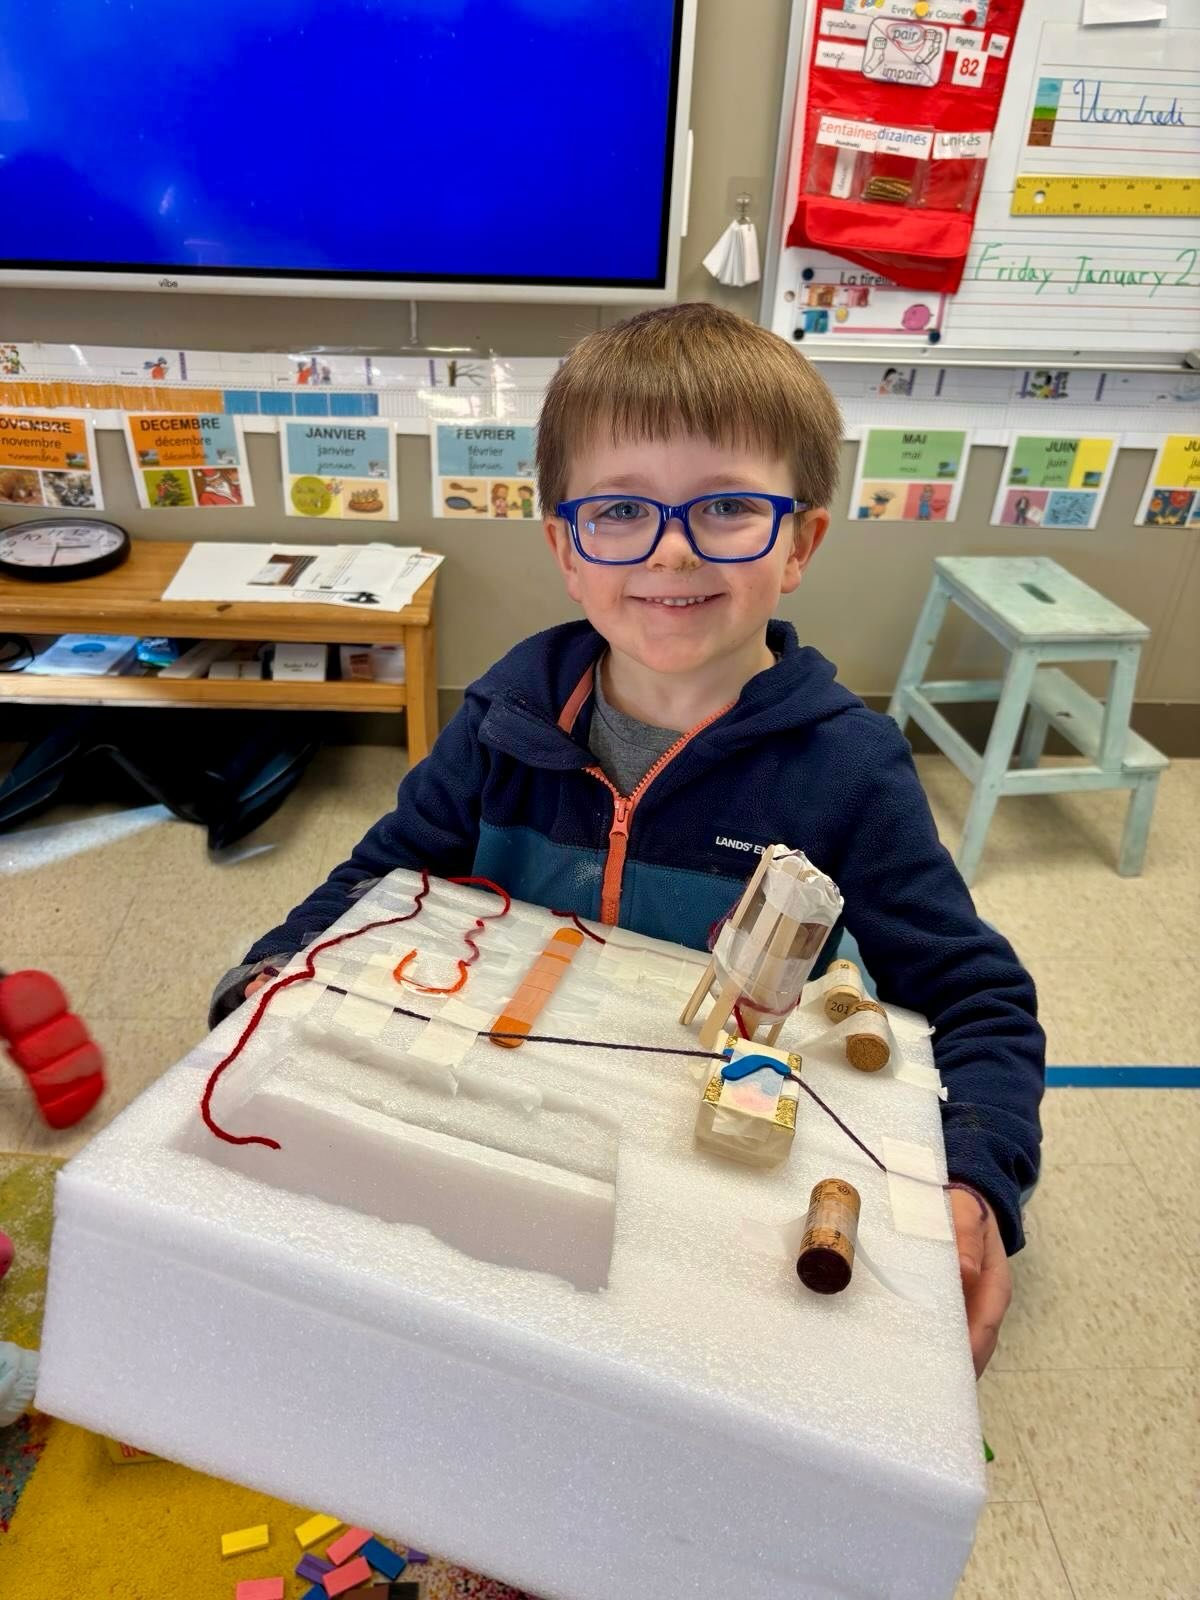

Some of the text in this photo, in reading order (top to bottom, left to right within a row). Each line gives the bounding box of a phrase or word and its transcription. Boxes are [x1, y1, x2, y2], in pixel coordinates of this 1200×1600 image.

[892, 27, 918, 44] pair
[882, 64, 921, 81] impair
[959, 58, 980, 77] 82
[820, 121, 877, 141] centaines
[878, 128, 927, 146] dizaines
[974, 243, 1053, 295] Friday
[1068, 256, 1166, 298] January
[159, 278, 178, 288] vibe
[840, 271, 857, 286] La
[0, 417, 72, 434] OVEMBRE
[140, 417, 221, 431] DECEMBRE
[154, 435, 213, 447] décembre
[305, 427, 367, 441] JANVIER
[456, 428, 516, 441] FEVRIER
[902, 433, 928, 445] MAI
[1, 436, 62, 449] novembre
[1045, 441, 1079, 453] JUIN
[317, 444, 356, 457] janvier
[715, 836, 753, 852] LANDS'
